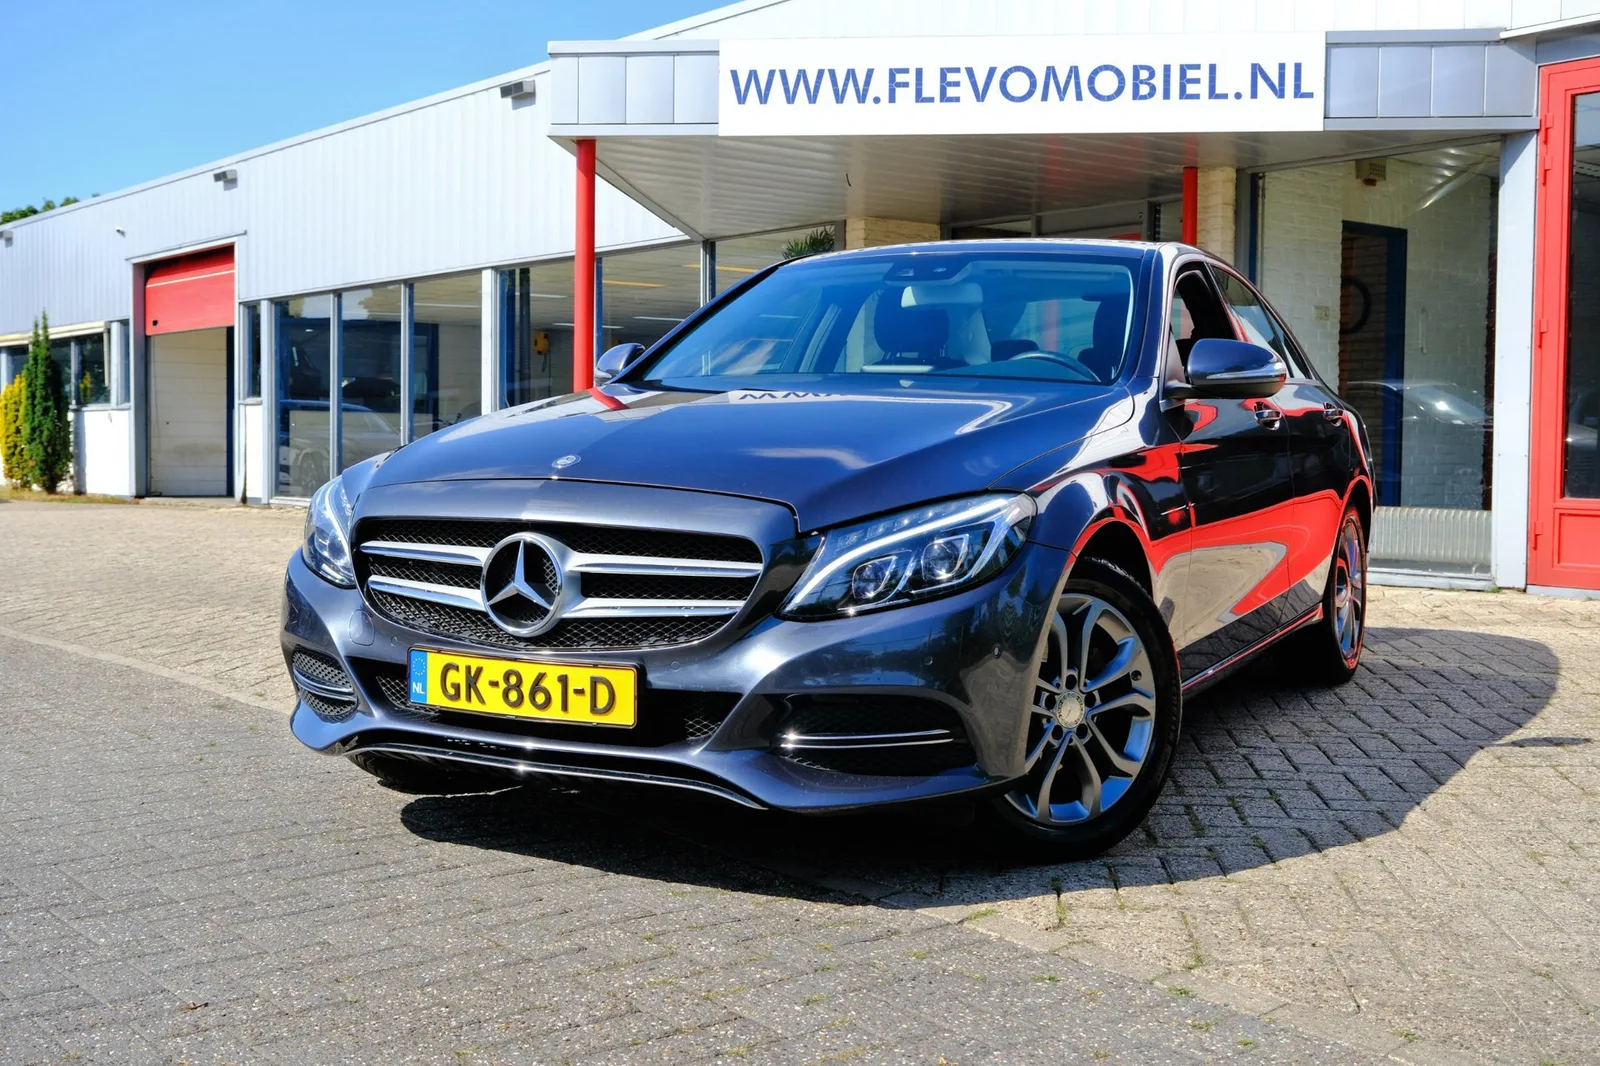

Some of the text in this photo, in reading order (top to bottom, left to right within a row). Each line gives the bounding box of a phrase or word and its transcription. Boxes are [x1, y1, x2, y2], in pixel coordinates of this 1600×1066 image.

[729, 62, 1315, 105] WWW.FLEVOMOBIEL.NL
[412, 682, 425, 695] NL
[440, 662, 616, 715] GK-861-D
